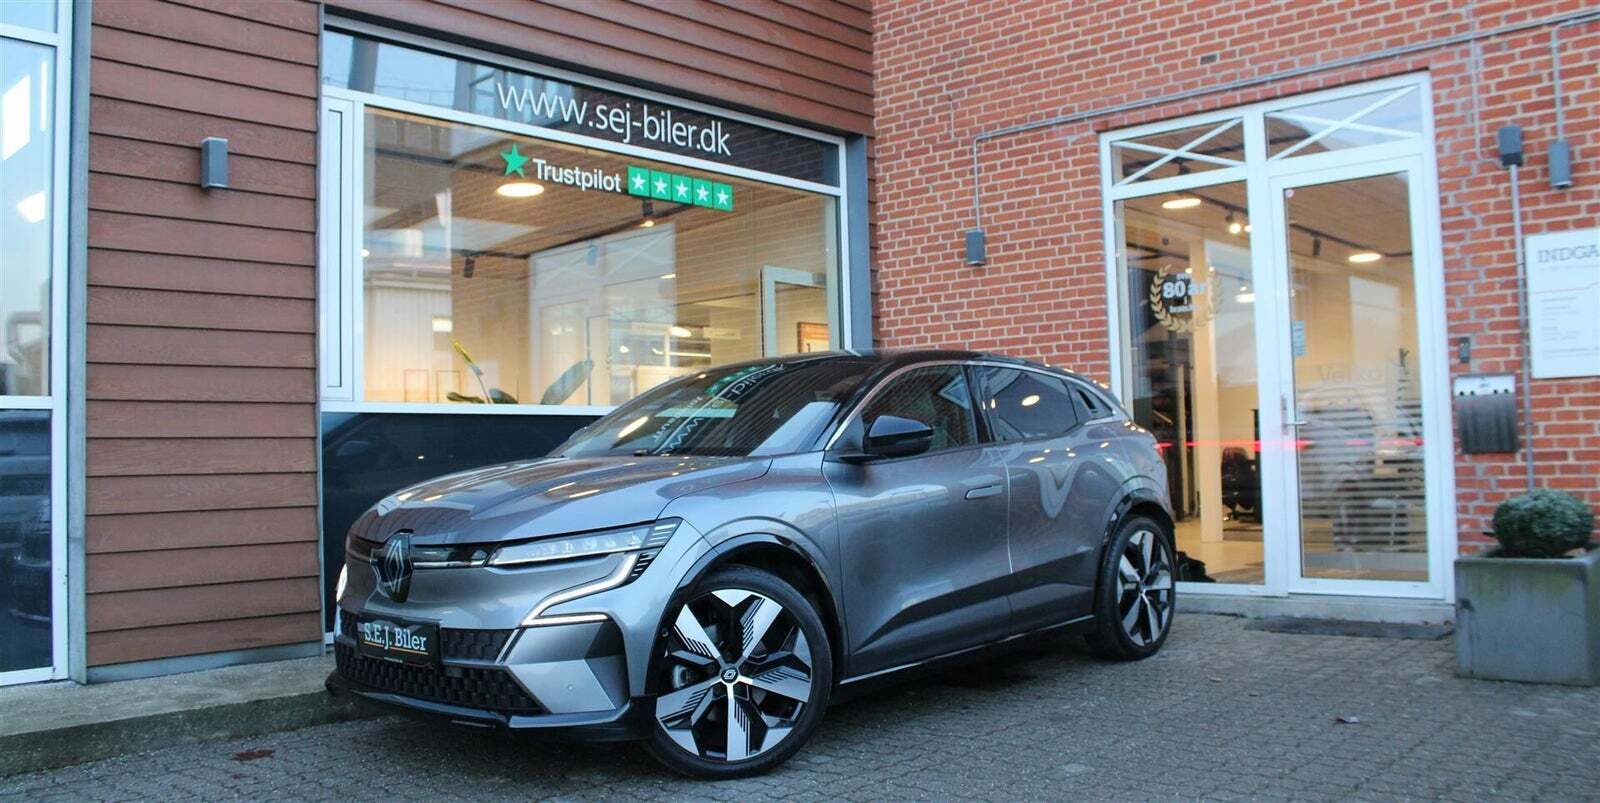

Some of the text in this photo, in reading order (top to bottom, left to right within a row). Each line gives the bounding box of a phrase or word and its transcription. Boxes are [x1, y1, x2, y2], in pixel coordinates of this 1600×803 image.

[496, 82, 732, 156] www.sej-biler.dk
[532, 158, 622, 193] Trustpilot
[1162, 281, 1186, 298] 80
[364, 623, 427, 651] S.E.J. Biler
